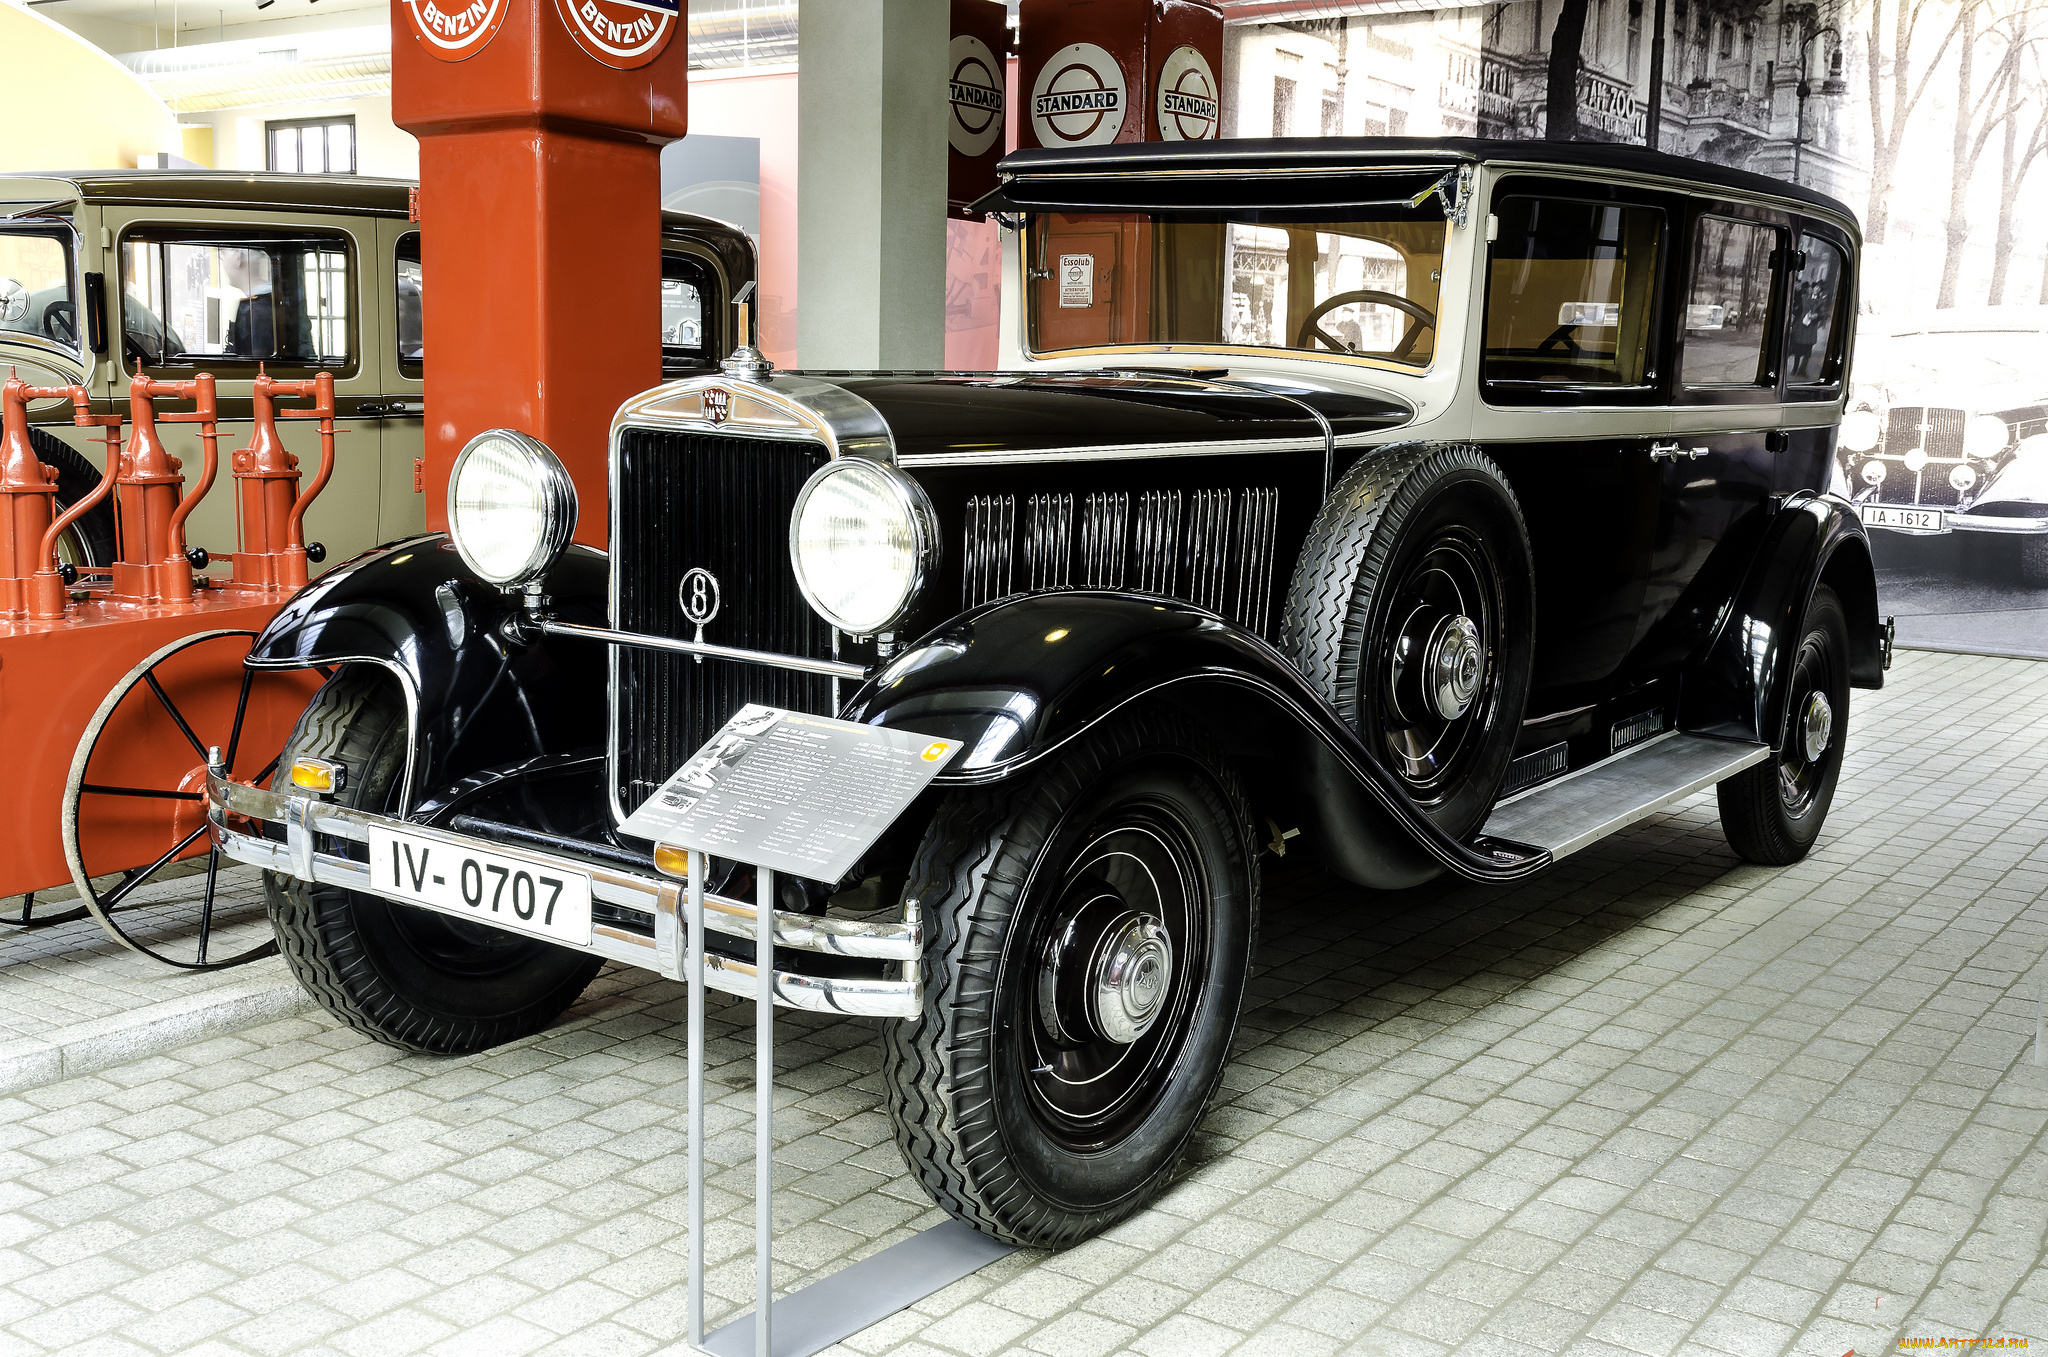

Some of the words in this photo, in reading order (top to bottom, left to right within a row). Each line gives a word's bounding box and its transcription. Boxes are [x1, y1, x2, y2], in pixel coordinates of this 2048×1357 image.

[422, 2, 488, 36] BENZIN
[580, 0, 655, 44] BENZIN
[949, 84, 1002, 109] TANDARD
[1036, 92, 1118, 114] STANDARD
[1164, 95, 1216, 118] STANDARD
[1063, 257, 1090, 266] Essolub
[692, 573, 707, 617] 8
[460, 858, 564, 926] 0707
